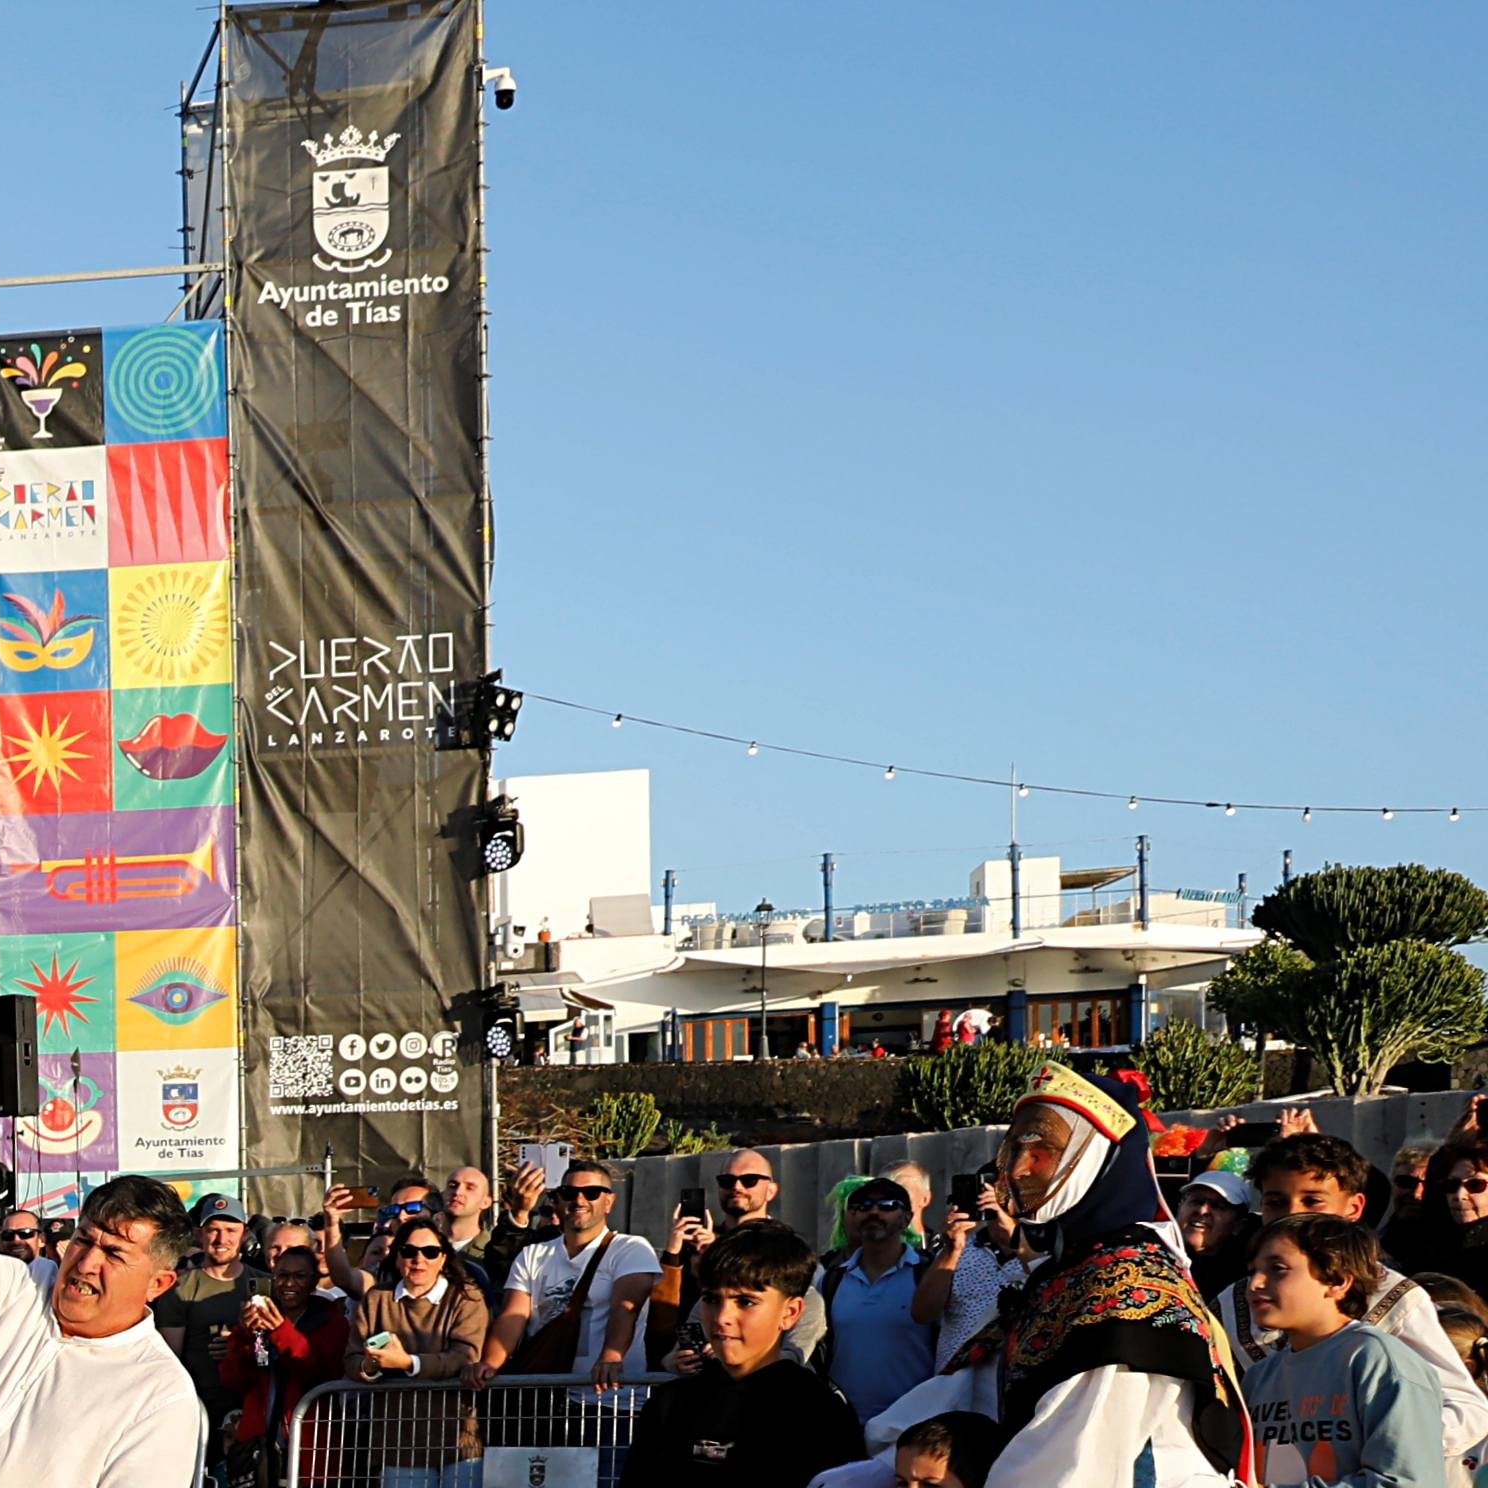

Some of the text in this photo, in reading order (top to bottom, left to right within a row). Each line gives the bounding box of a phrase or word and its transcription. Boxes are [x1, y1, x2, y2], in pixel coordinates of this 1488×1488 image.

[257, 274, 450, 309] Ayuntamiento
[305, 300, 401, 327] de Tías
[269, 632, 454, 681] PUERTO
[267, 680, 455, 726] CARMEN
[268, 726, 456, 747] LANZAROTE
[135, 1136, 226, 1150] Ayuntamiento
[158, 1148, 173, 1158] de
